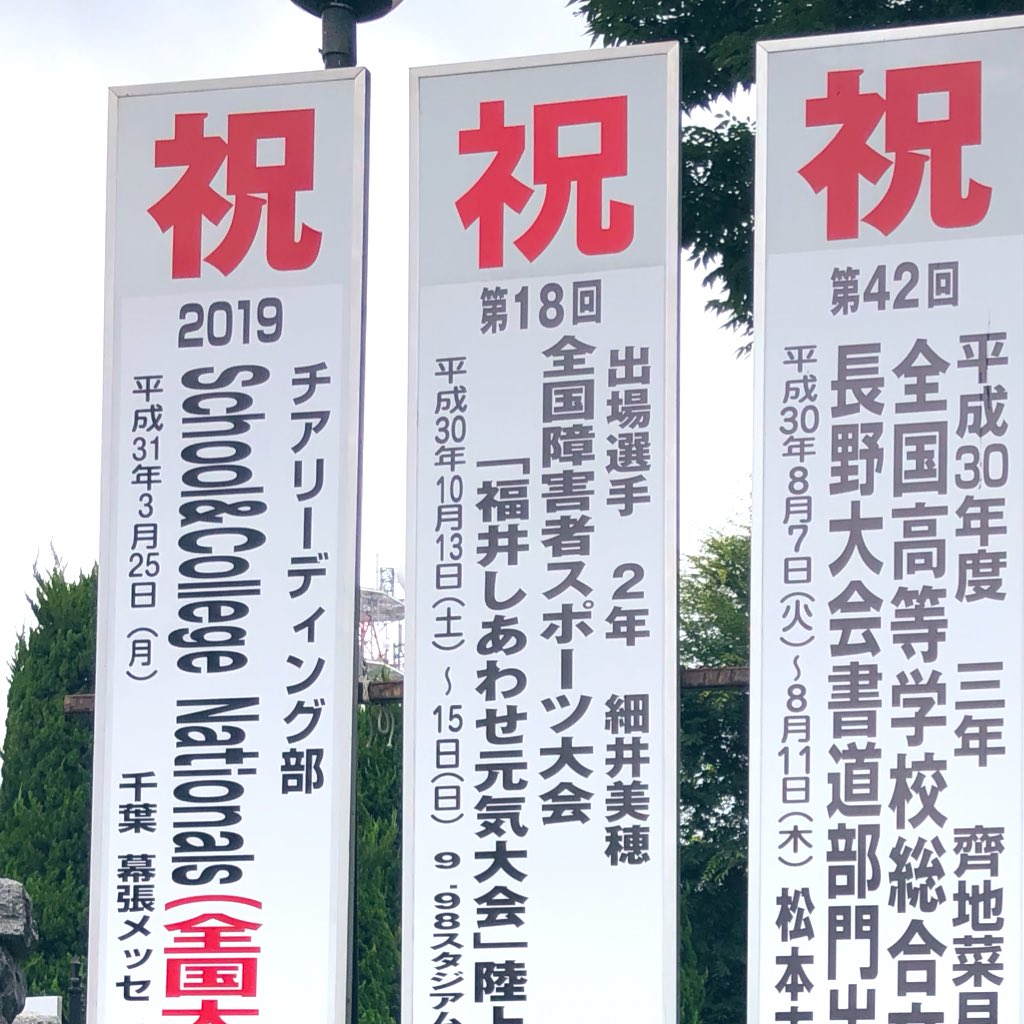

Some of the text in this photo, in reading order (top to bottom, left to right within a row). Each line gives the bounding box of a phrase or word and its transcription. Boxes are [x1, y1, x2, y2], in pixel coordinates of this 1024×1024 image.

[147, 109, 322, 279] 祝
[455, 96, 634, 269] 祝
[798, 61, 992, 240] 祝
[178, 298, 282, 348] 2019
[481, 280, 601, 334] 第18回
[831, 262, 958, 315] 第42回
[955, 332, 1008, 602] 平成30年度
[281, 362, 330, 794] チアリーディング部
[539, 336, 596, 825] 全国障害者スポーツ大会
[605, 346, 651, 866] 出場選手 2年 細井美穂
[955, 662, 1005, 766] 三年
[119, 772, 157, 833] 千葉
[116, 854, 156, 1001] 幕張メッセ
